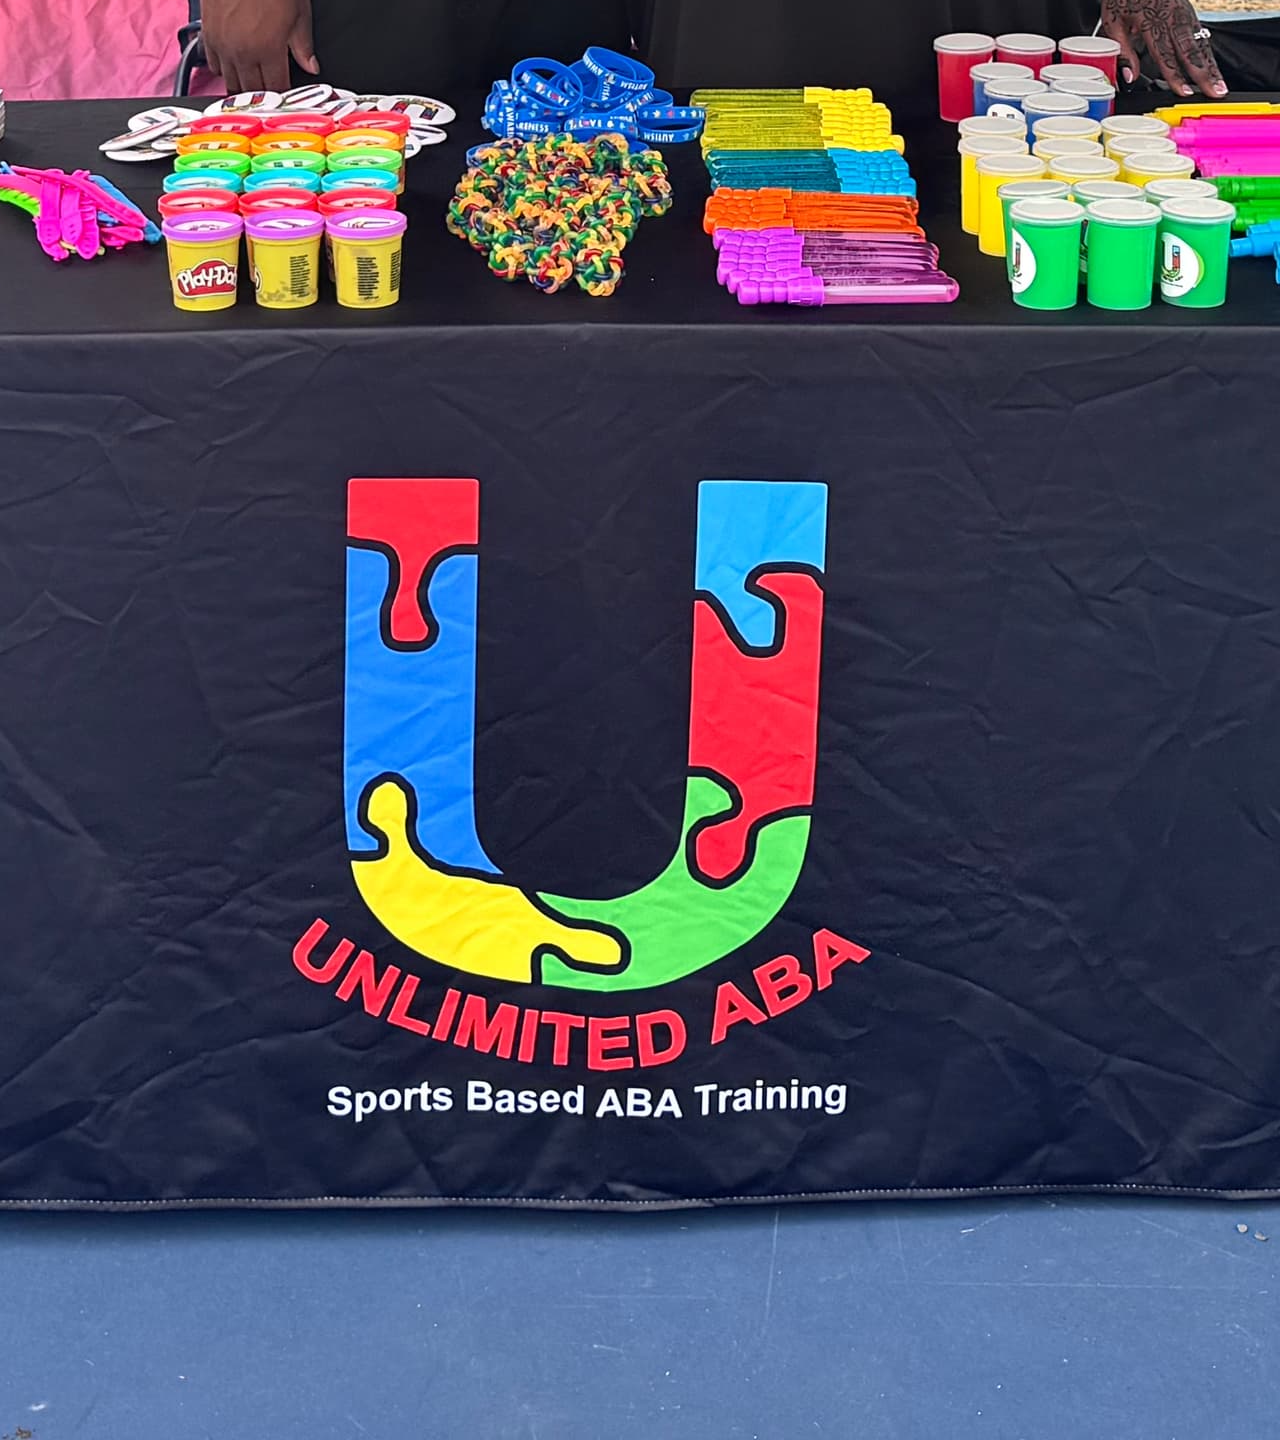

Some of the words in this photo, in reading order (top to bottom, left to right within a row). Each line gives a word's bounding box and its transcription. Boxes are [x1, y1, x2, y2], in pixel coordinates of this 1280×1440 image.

[292, 918, 686, 1071] UNLIMITED
[710, 927, 871, 1045] ABA
[326, 1081, 453, 1122] Sports
[466, 1080, 584, 1115] Based
[595, 1086, 683, 1119] ABA
[694, 1078, 848, 1114] Training
